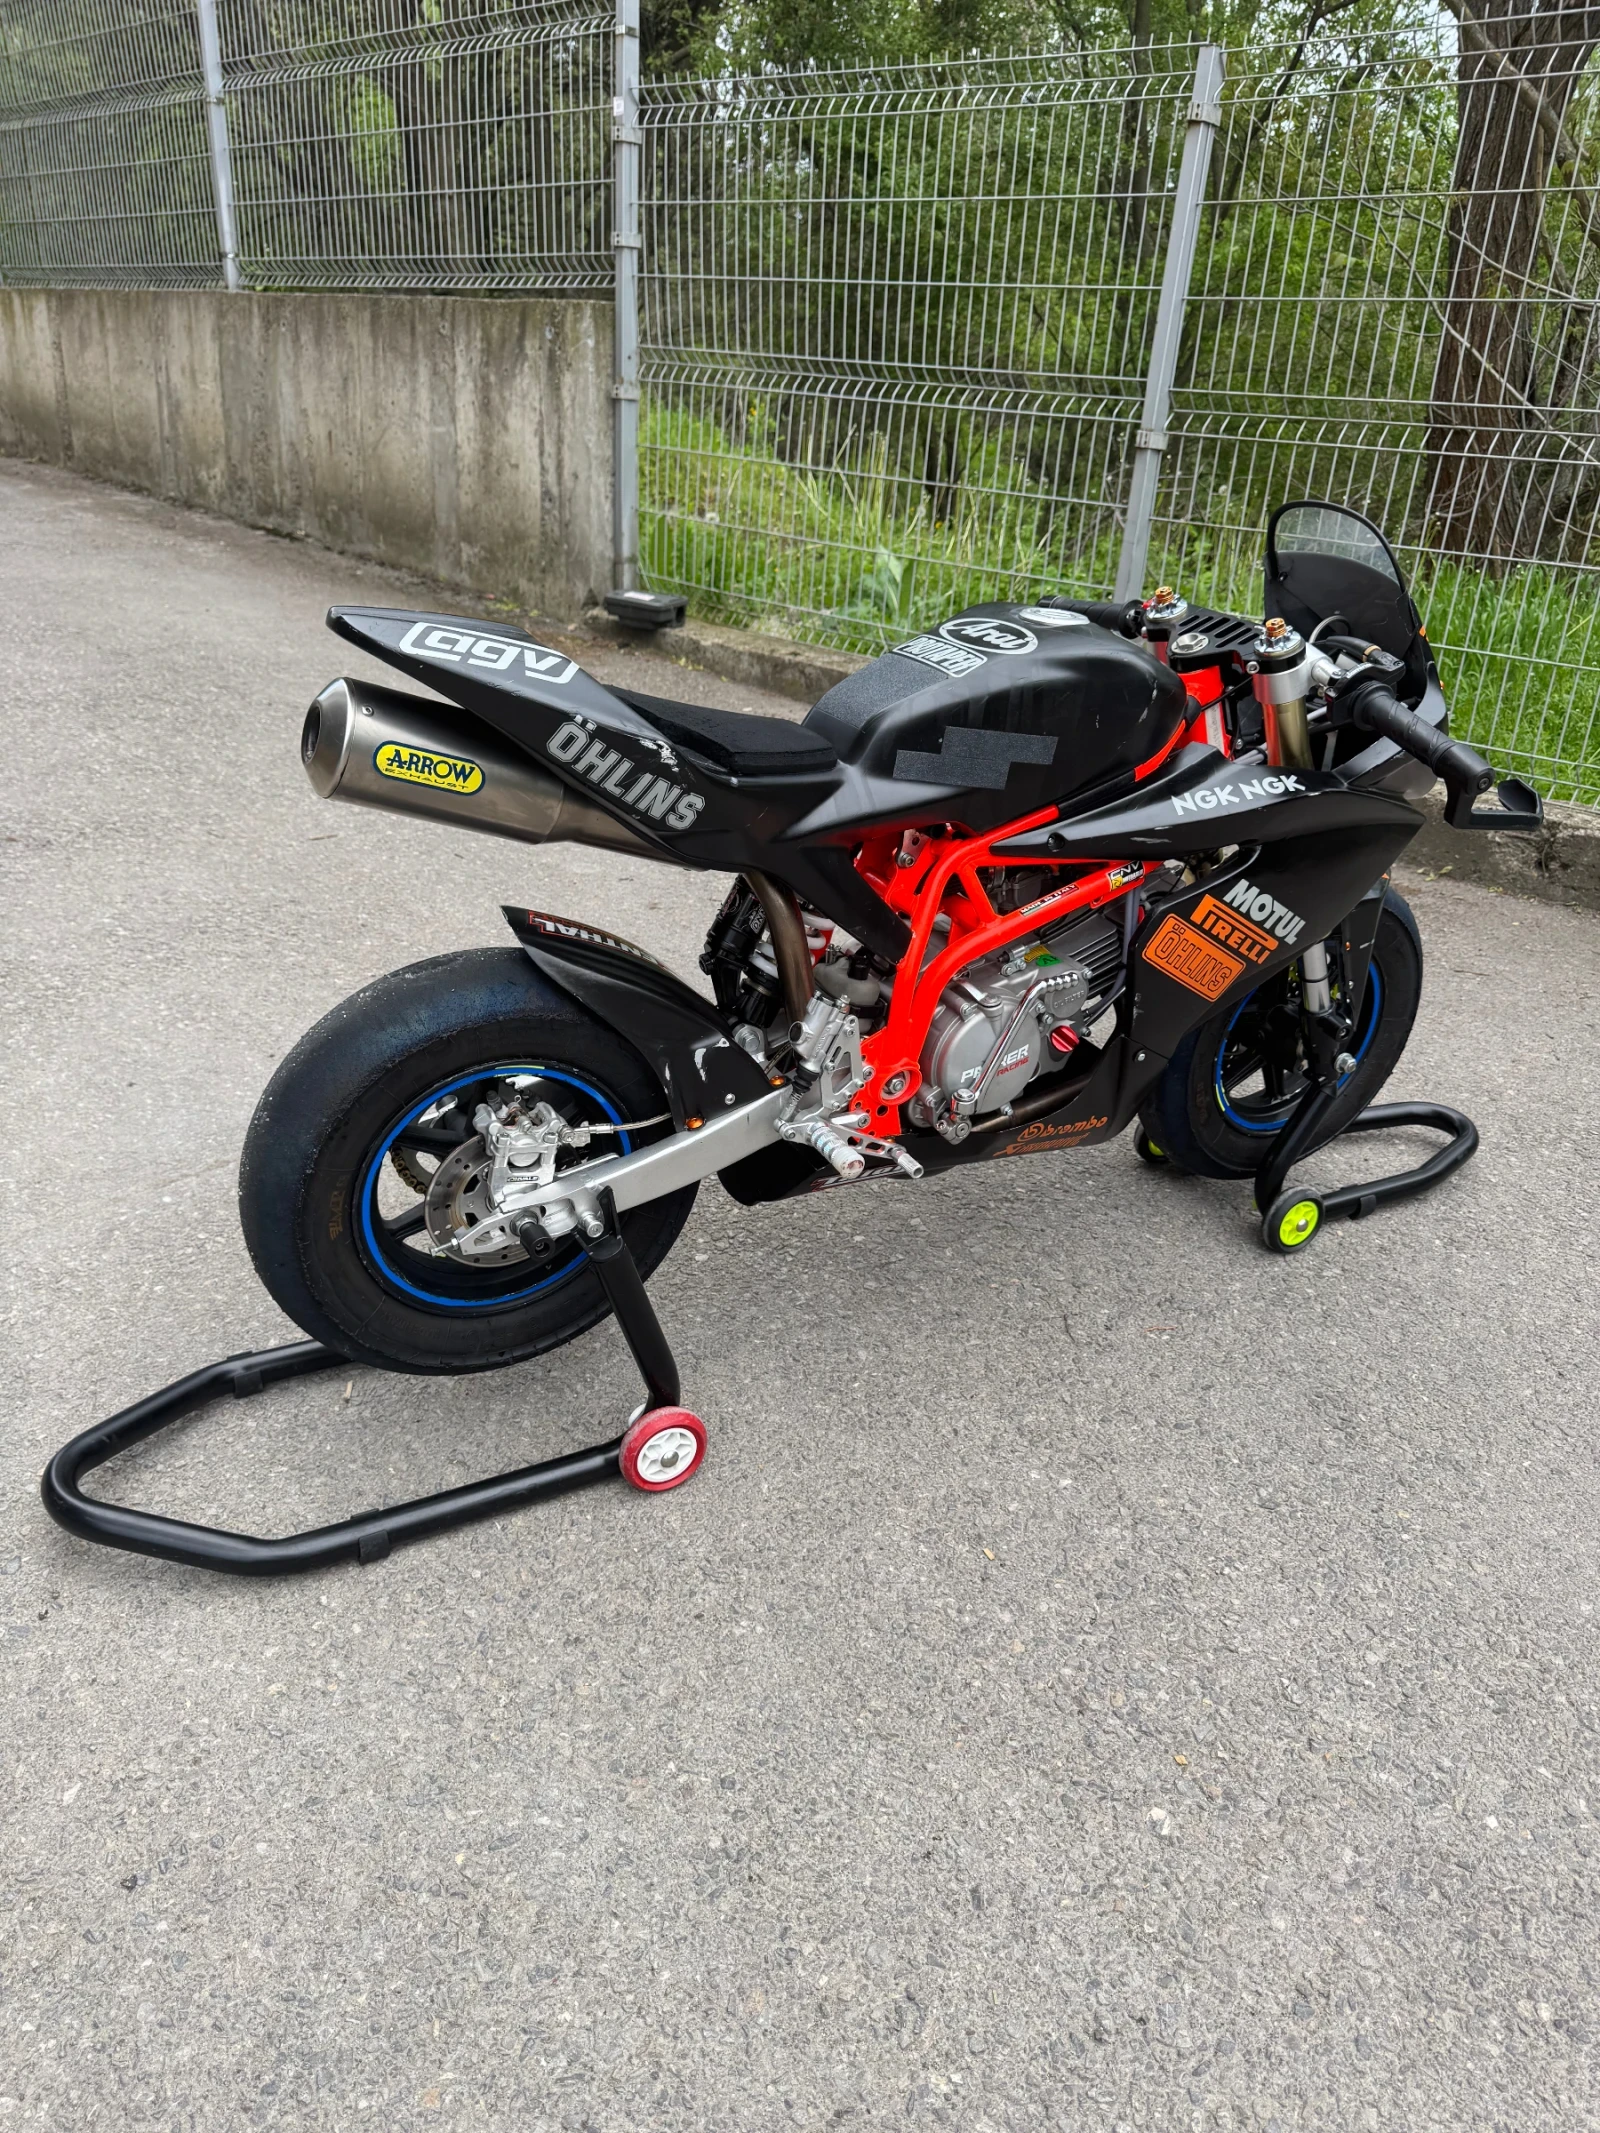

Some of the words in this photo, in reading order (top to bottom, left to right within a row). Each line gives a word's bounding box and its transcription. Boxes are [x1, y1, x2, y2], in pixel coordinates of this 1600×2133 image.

[410, 625, 570, 676] agv
[950, 622, 1034, 649] Arai
[383, 767, 469, 790] EXHAUST
[386, 749, 476, 784] ARROW
[546, 714, 706, 830] ÖHLINS
[1171, 784, 1240, 816] NGK
[1239, 774, 1306, 801] NGK
[1190, 893, 1279, 964] PIRELLI
[1223, 878, 1306, 945] MOTUL
[1154, 923, 1232, 992] ÖHLINS
[997, 1056, 1030, 1078] RACING
